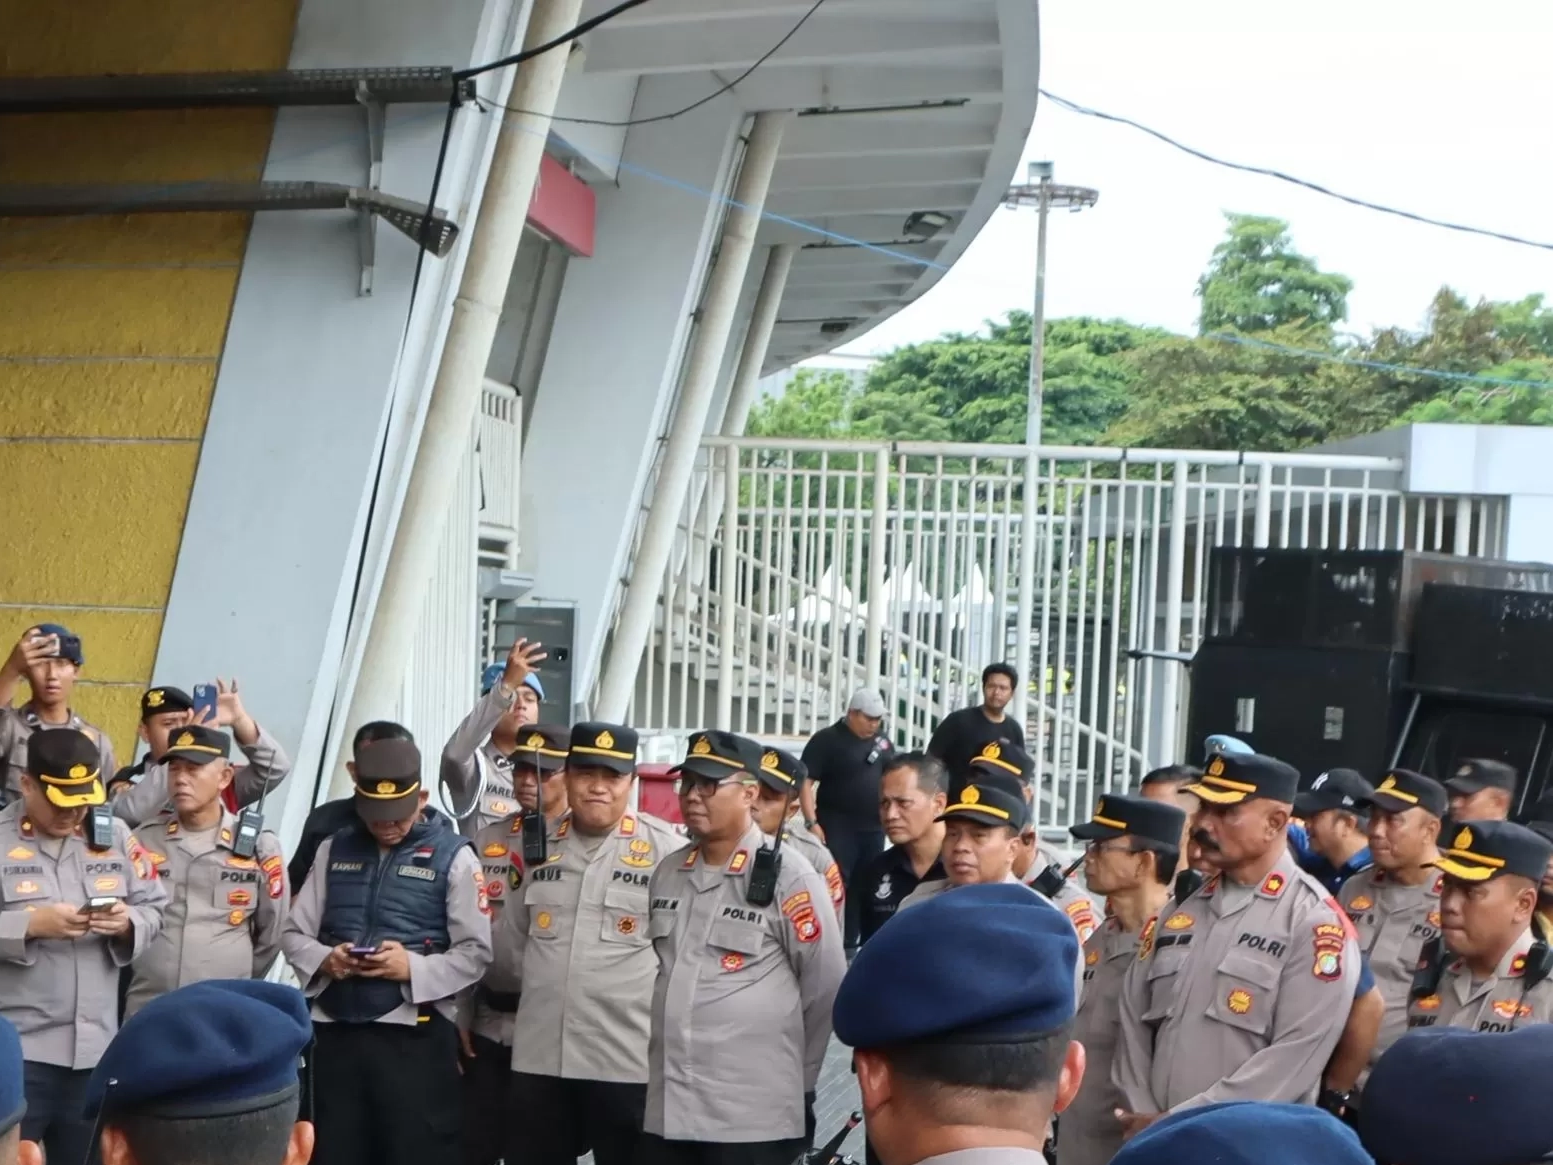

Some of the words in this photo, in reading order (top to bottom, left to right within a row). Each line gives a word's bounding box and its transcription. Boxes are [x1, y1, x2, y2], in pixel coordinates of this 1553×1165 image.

[86, 863, 122, 873] POLRI
[613, 871, 649, 886] POLR
[723, 907, 763, 924] POLRI
[1413, 924, 1436, 940] POL
[1238, 932, 1286, 959] POLRI
